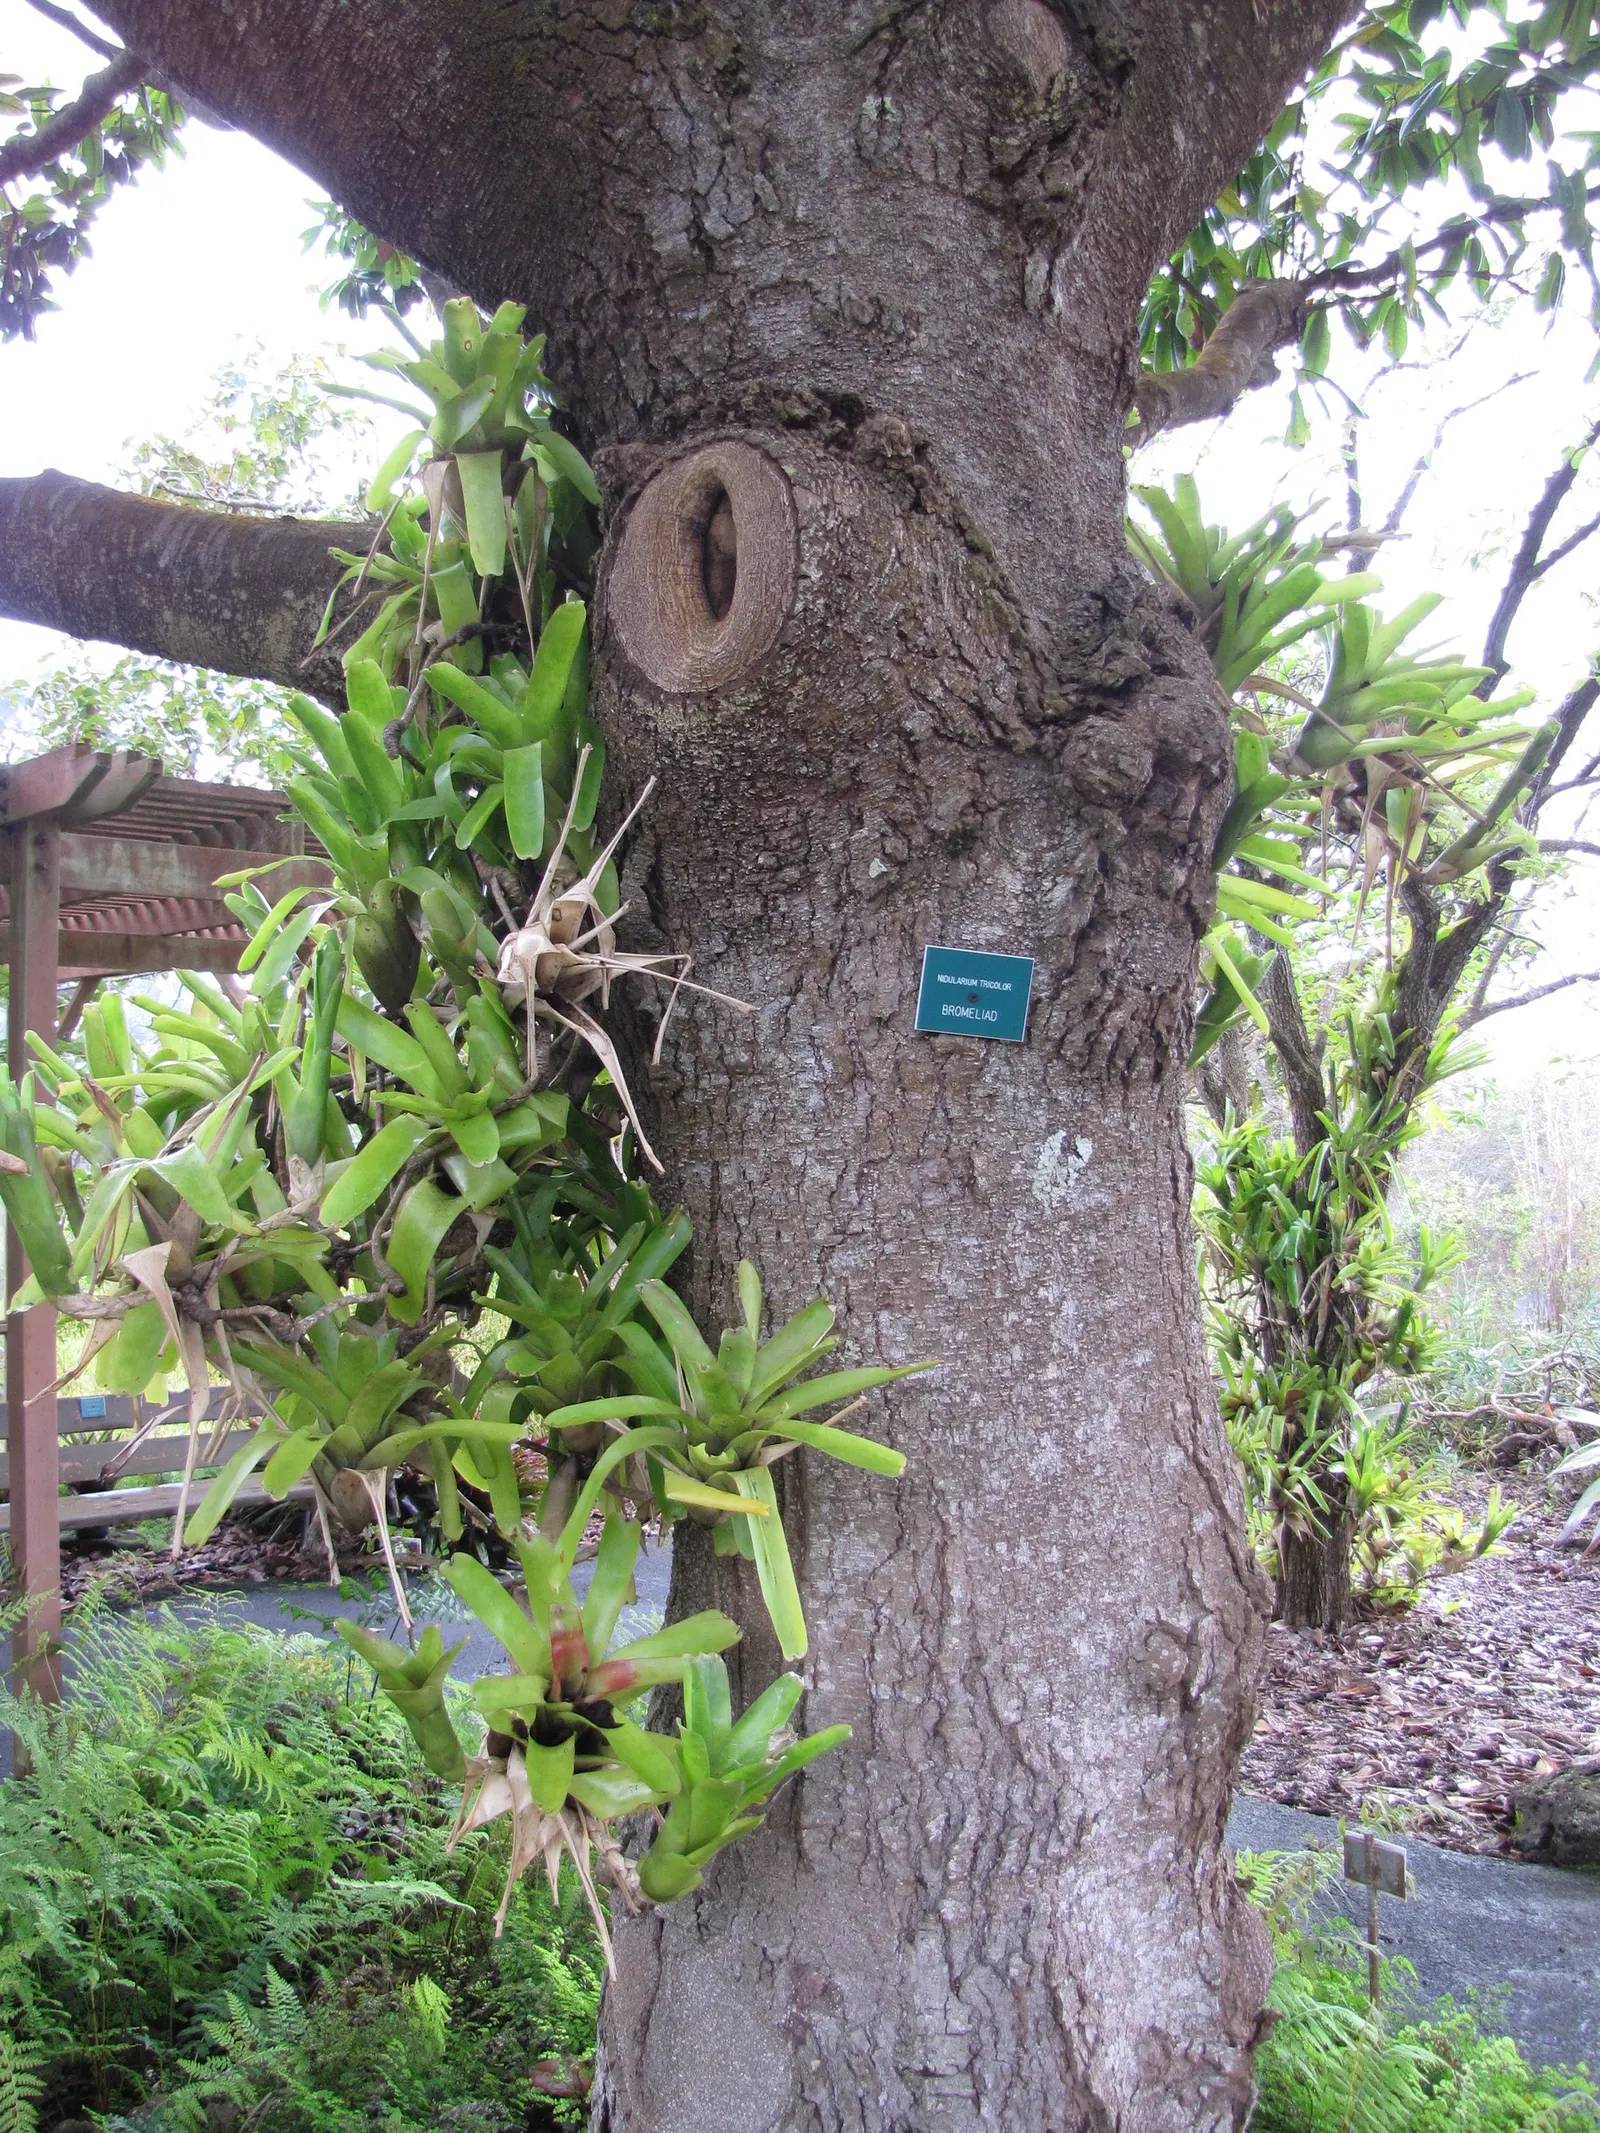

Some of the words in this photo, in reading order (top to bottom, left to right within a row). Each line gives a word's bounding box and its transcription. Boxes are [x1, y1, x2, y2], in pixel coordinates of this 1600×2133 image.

[937, 974, 978, 987] NIDULARIUM
[980, 979, 1012, 991] TRICOLOR
[941, 1004, 998, 1022] BROMELIAD
